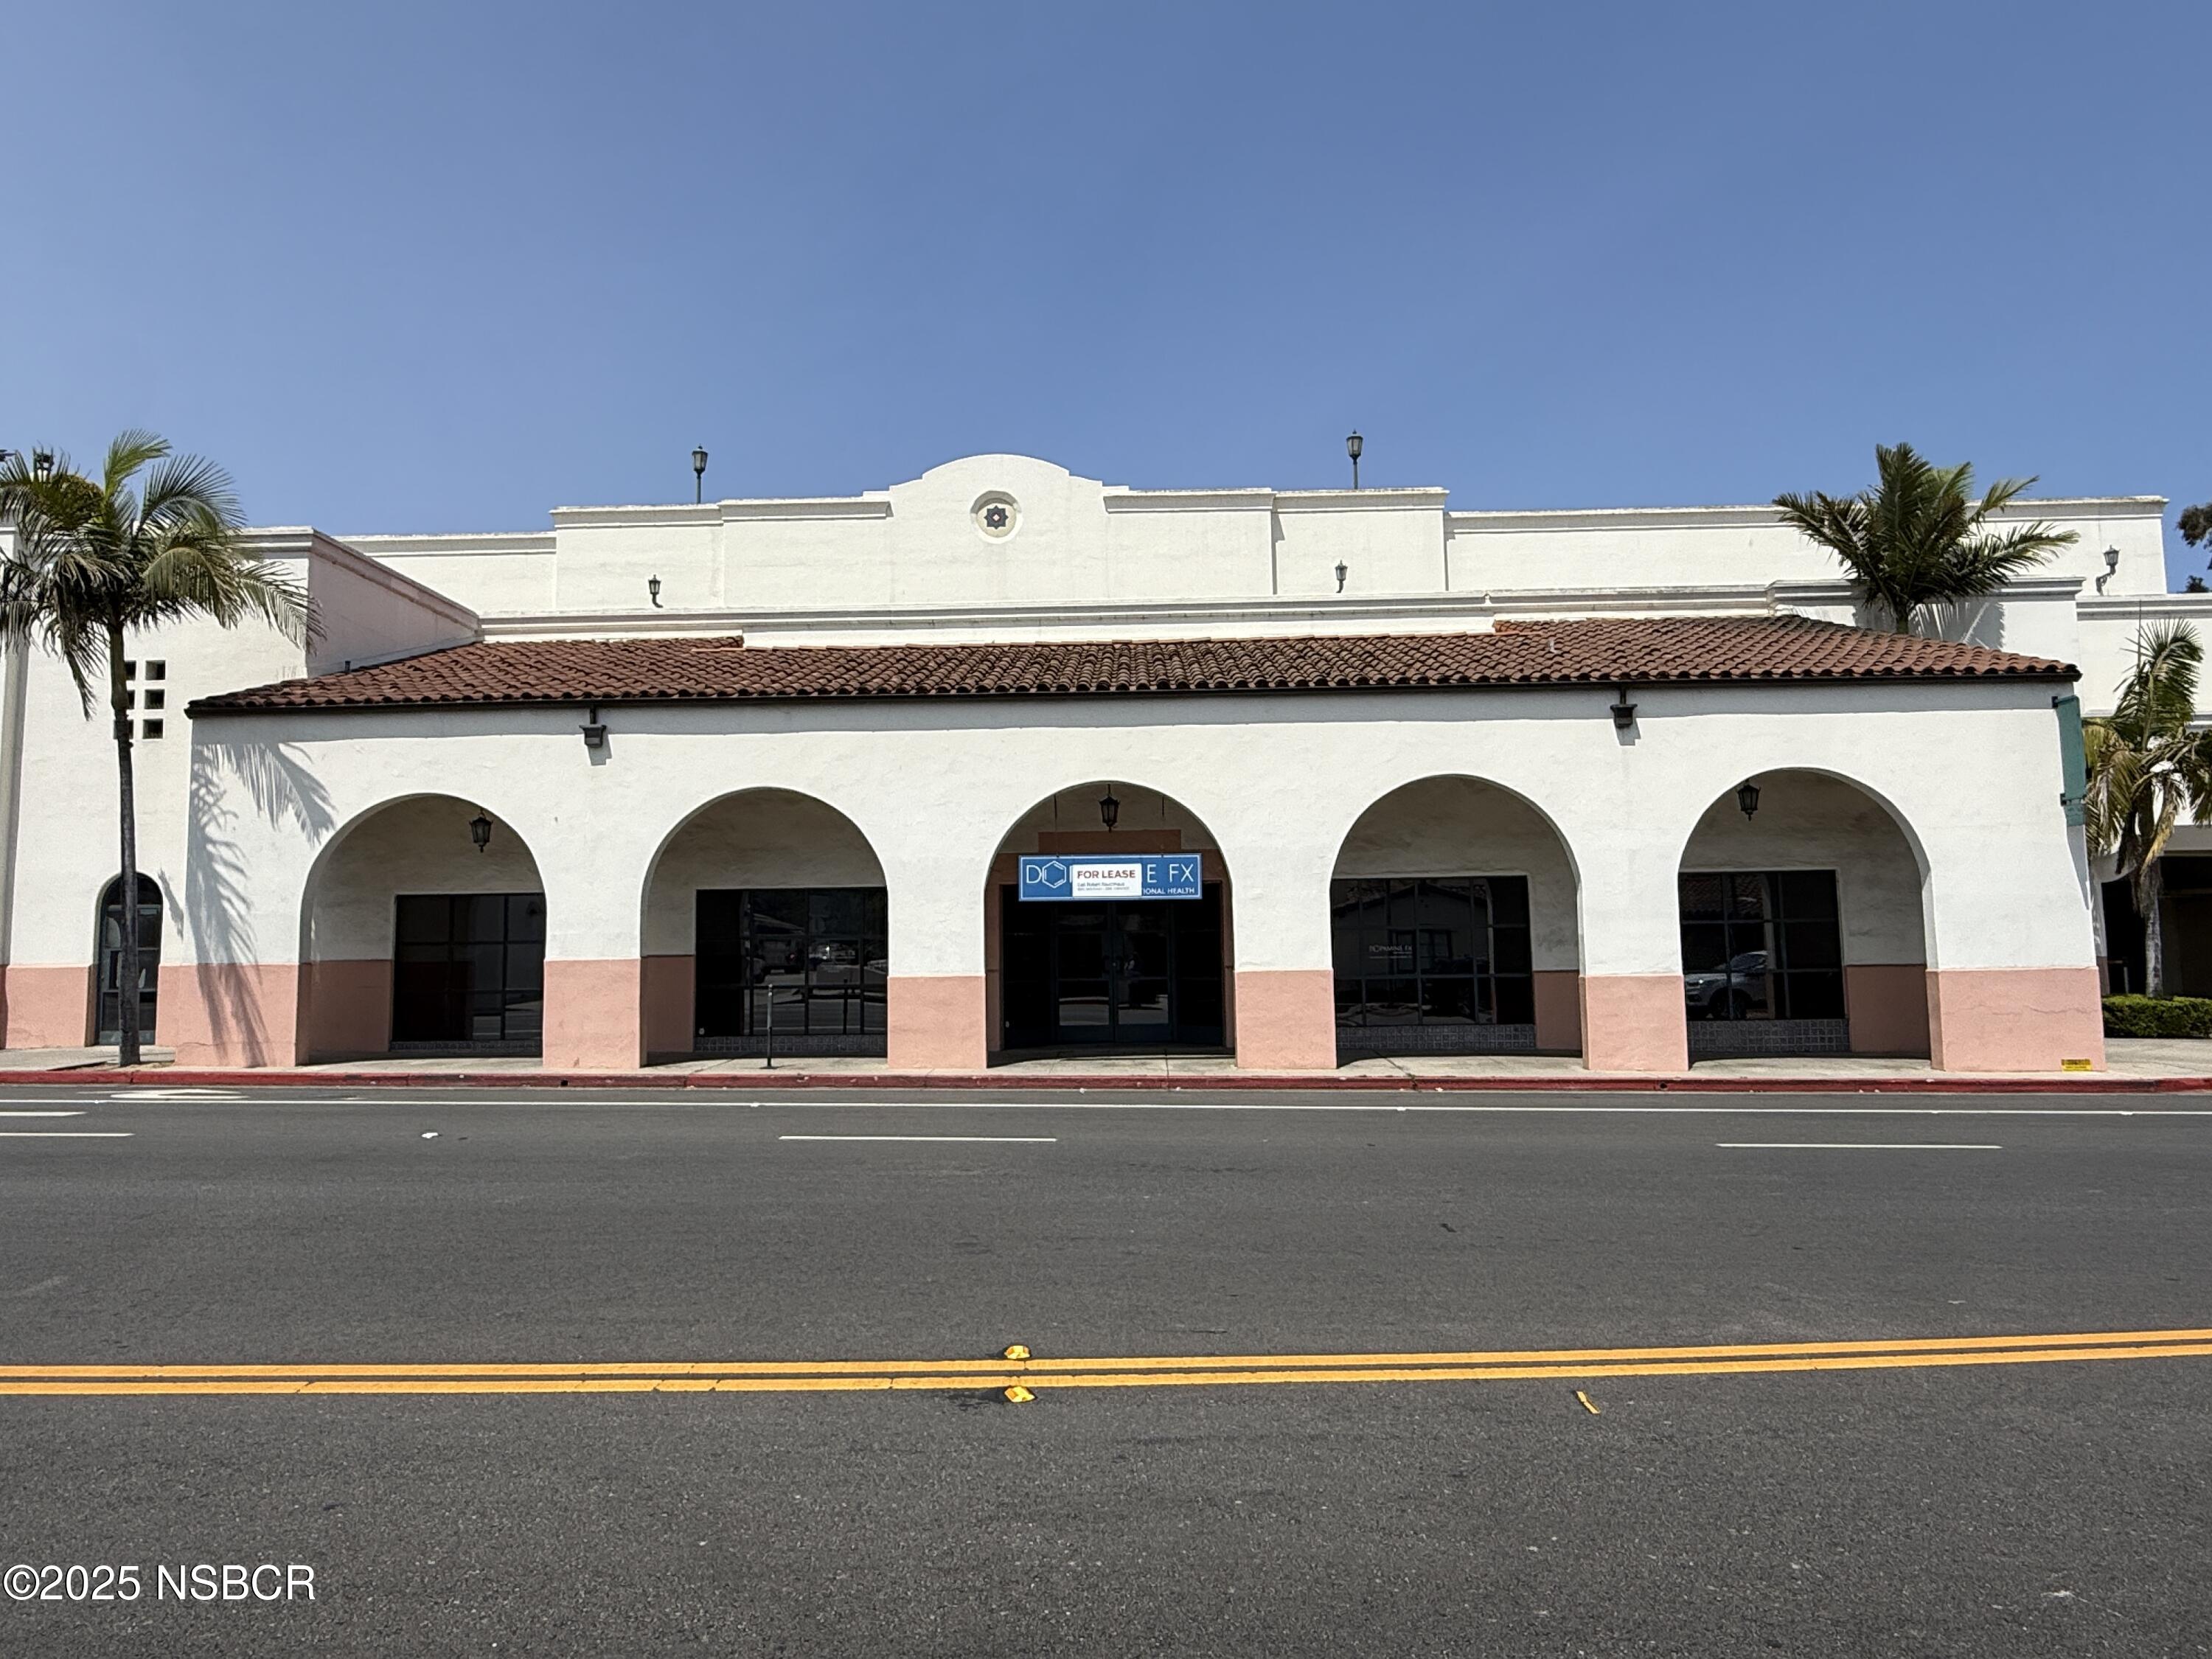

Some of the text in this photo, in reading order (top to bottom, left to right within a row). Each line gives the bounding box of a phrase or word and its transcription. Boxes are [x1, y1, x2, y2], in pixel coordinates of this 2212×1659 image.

[1077, 870, 1136, 879] FOR LEASE
[1169, 863, 1194, 883] FX
